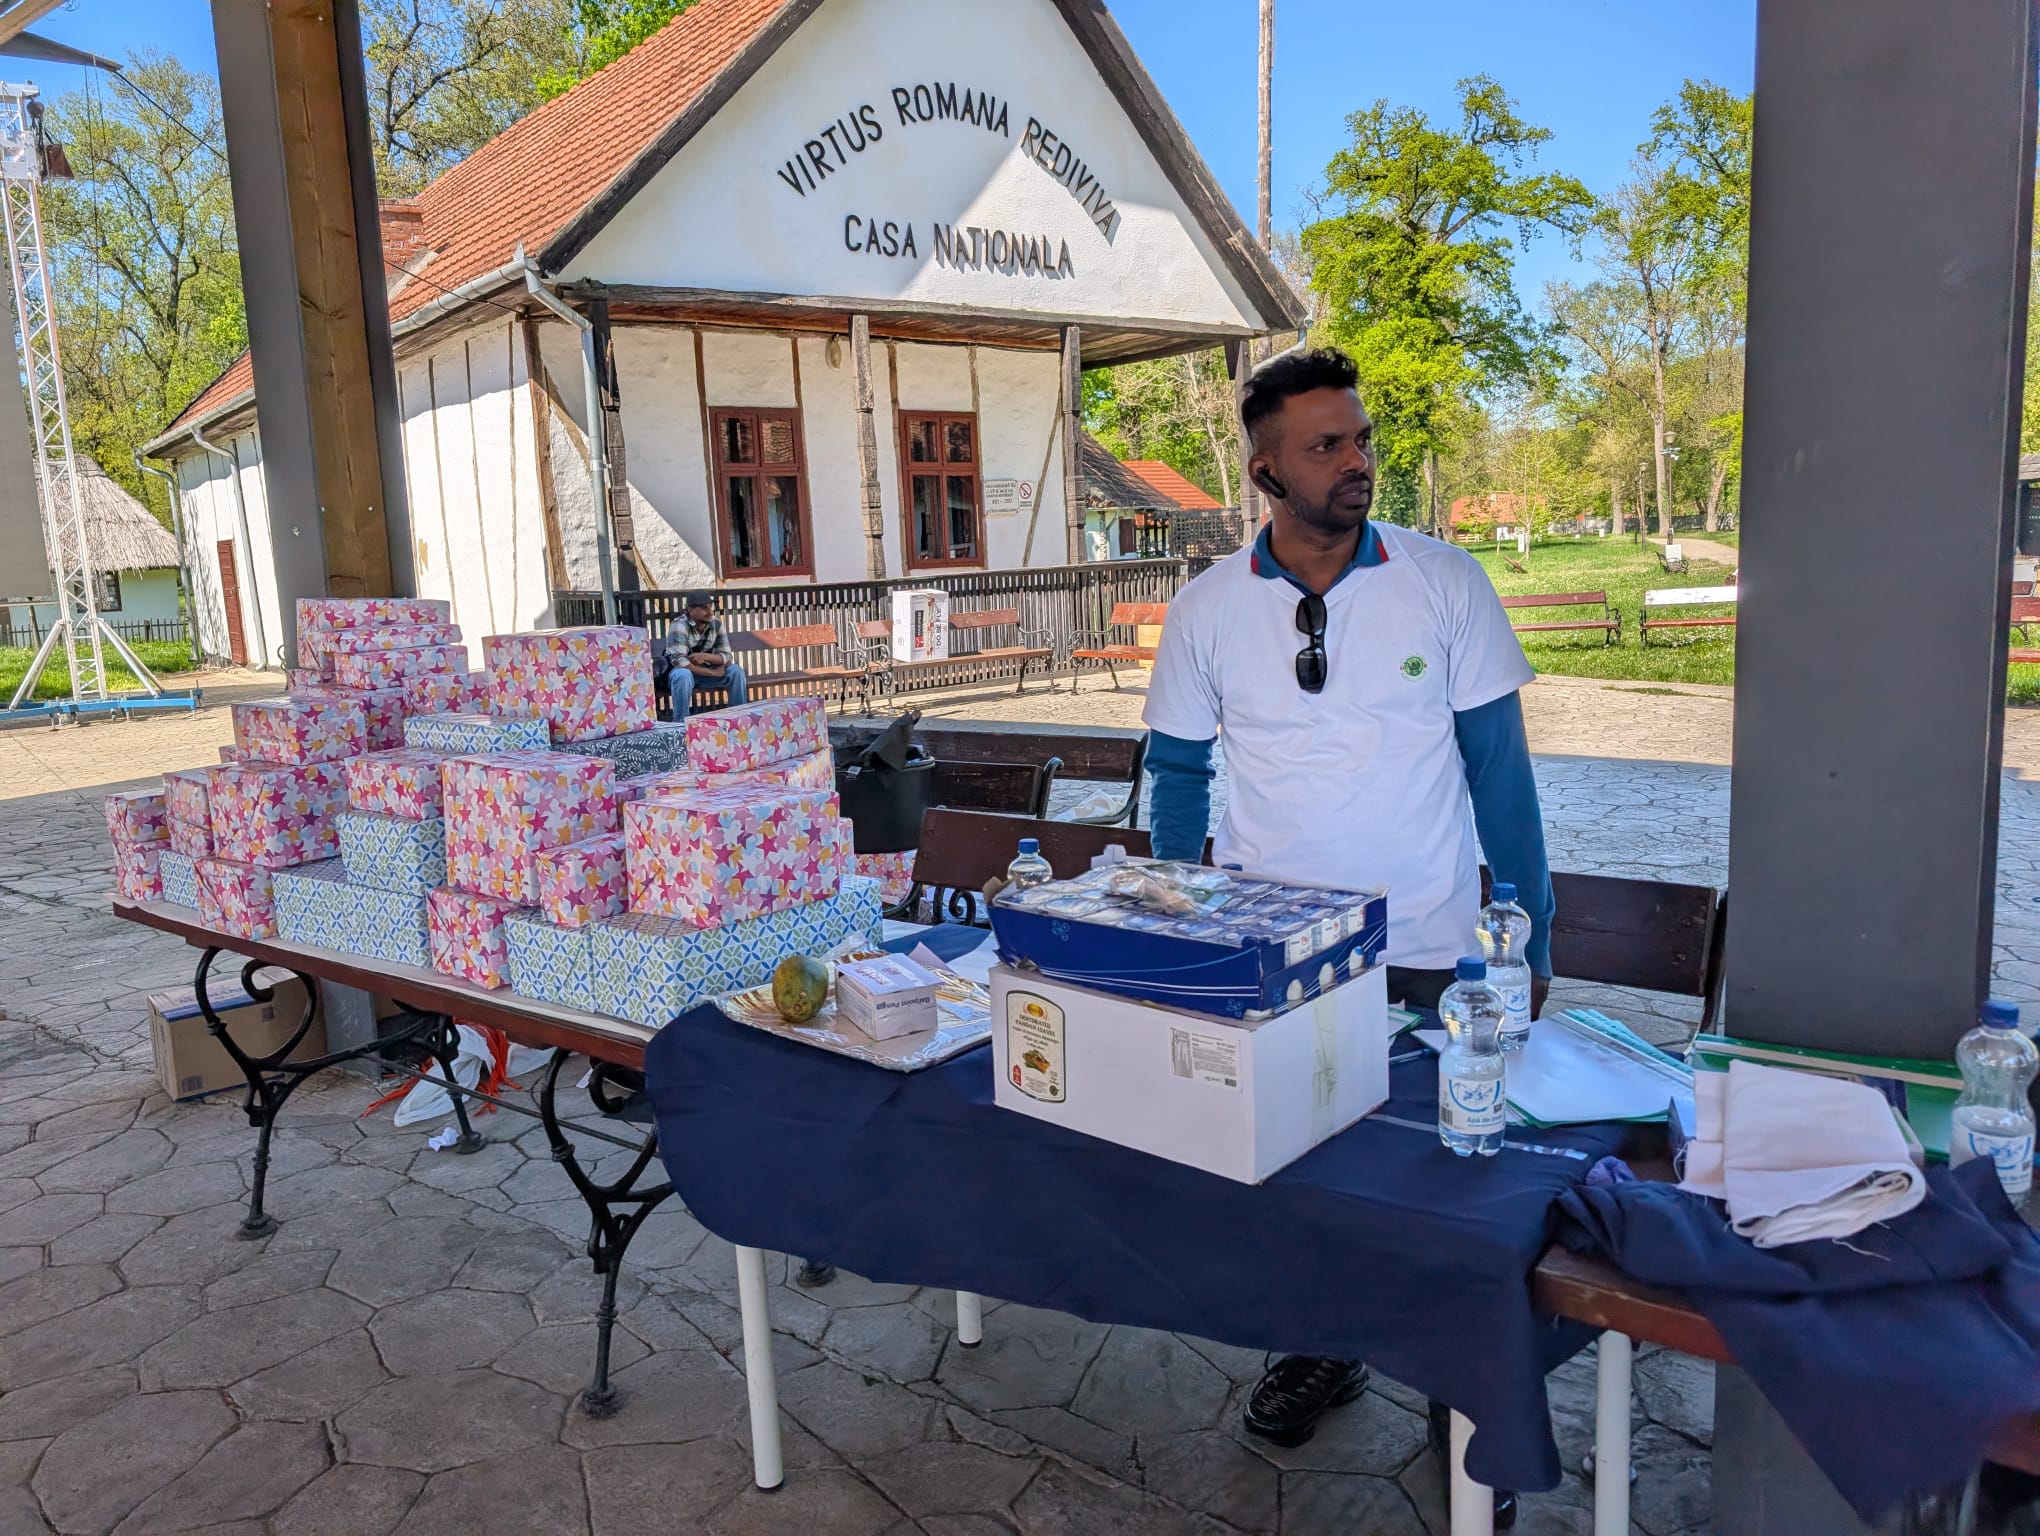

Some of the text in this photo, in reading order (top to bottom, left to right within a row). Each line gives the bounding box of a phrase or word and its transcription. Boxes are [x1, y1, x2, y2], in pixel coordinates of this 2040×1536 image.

[777, 82, 1117, 237] VIRTUS ROMANA REDIVIVA
[844, 214, 1073, 274] CASA NATIONALA
